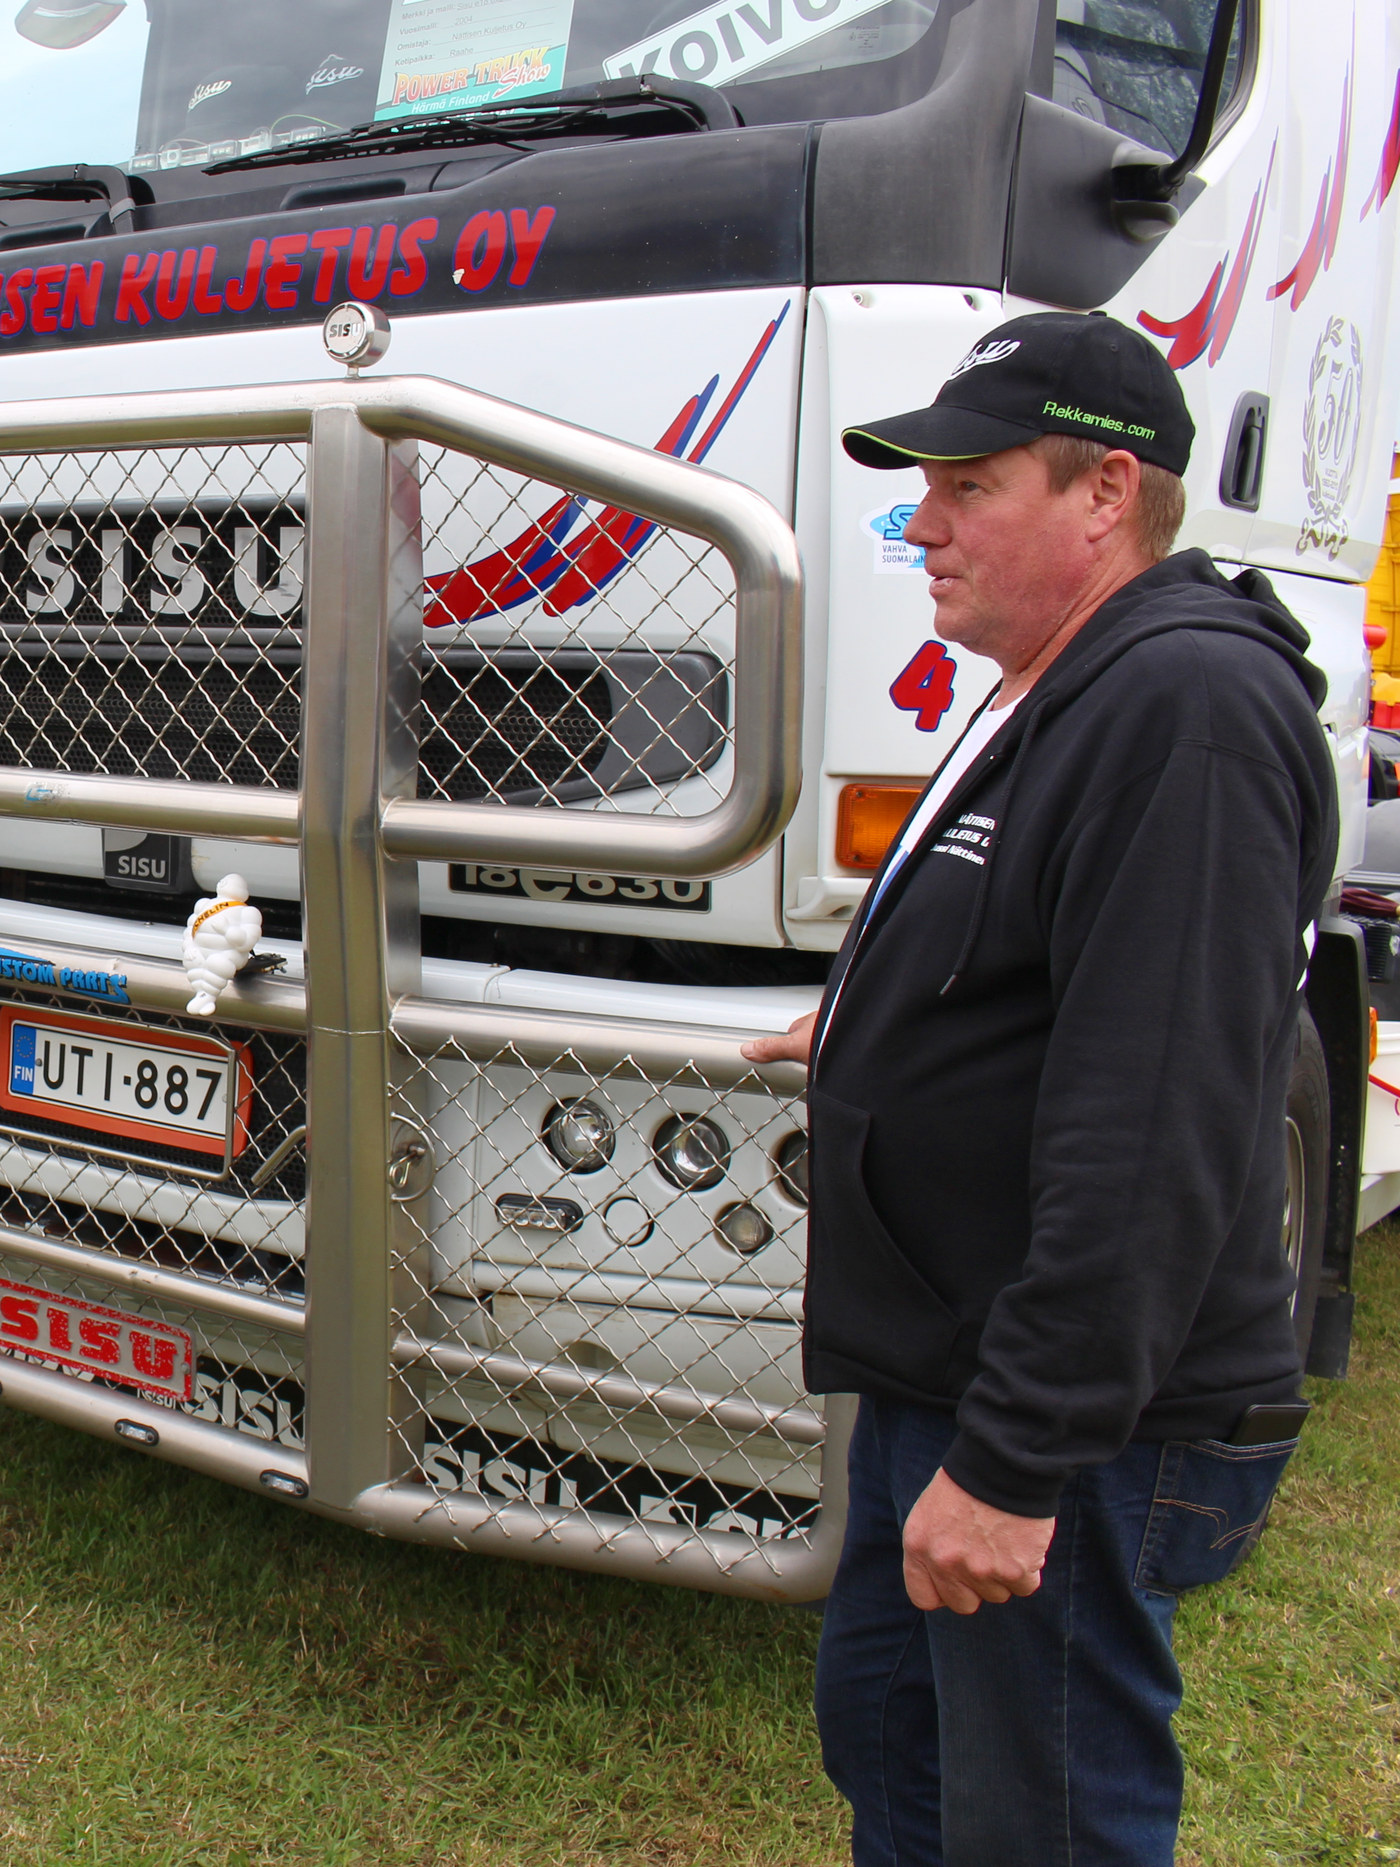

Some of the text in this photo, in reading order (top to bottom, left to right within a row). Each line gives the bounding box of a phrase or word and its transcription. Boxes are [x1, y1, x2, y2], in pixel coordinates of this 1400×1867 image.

[391, 46, 550, 106] POWER TRUCK
[492, 62, 551, 99] Show
[411, 91, 490, 115] Härmä Finland
[113, 216, 440, 328] KULJETUS
[452, 204, 558, 293] OY
[328, 322, 361, 338] SISU
[1042, 400, 1156, 441] Rekkamies.com
[882, 545, 907, 553] VAHVA
[882, 555, 926, 564] SUOMALAIN
[25, 525, 305, 617] SISU
[888, 639, 957, 732] 4
[117, 855, 166, 878] SISU
[60, 966, 131, 1005] PARTS
[14, 1064, 34, 1082] FIN
[42, 1040, 223, 1121] UTI-887
[0, 1295, 179, 1381] SISU
